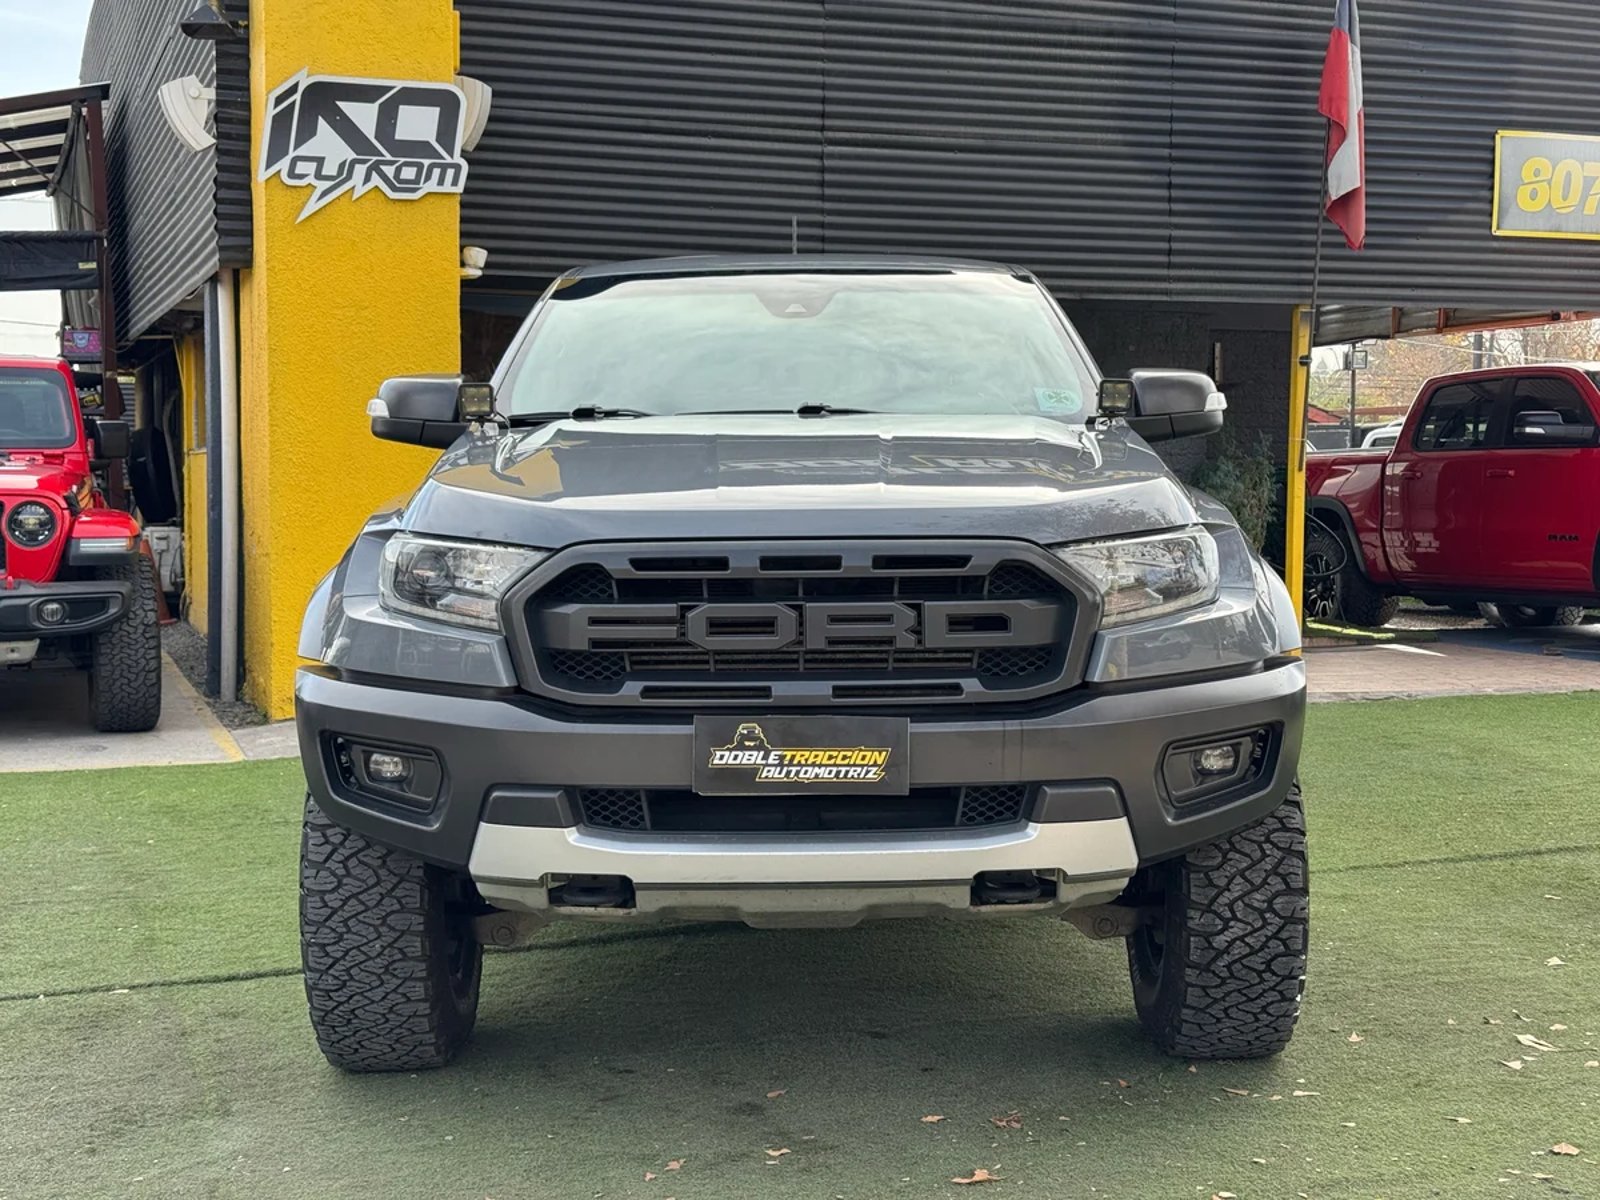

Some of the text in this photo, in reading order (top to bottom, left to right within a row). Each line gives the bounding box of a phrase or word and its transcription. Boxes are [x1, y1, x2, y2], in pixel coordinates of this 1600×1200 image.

[1548, 534, 1579, 542] RAM
[545, 601, 1060, 652] FORD
[760, 766, 879, 779] AUTOMOTRIZ
